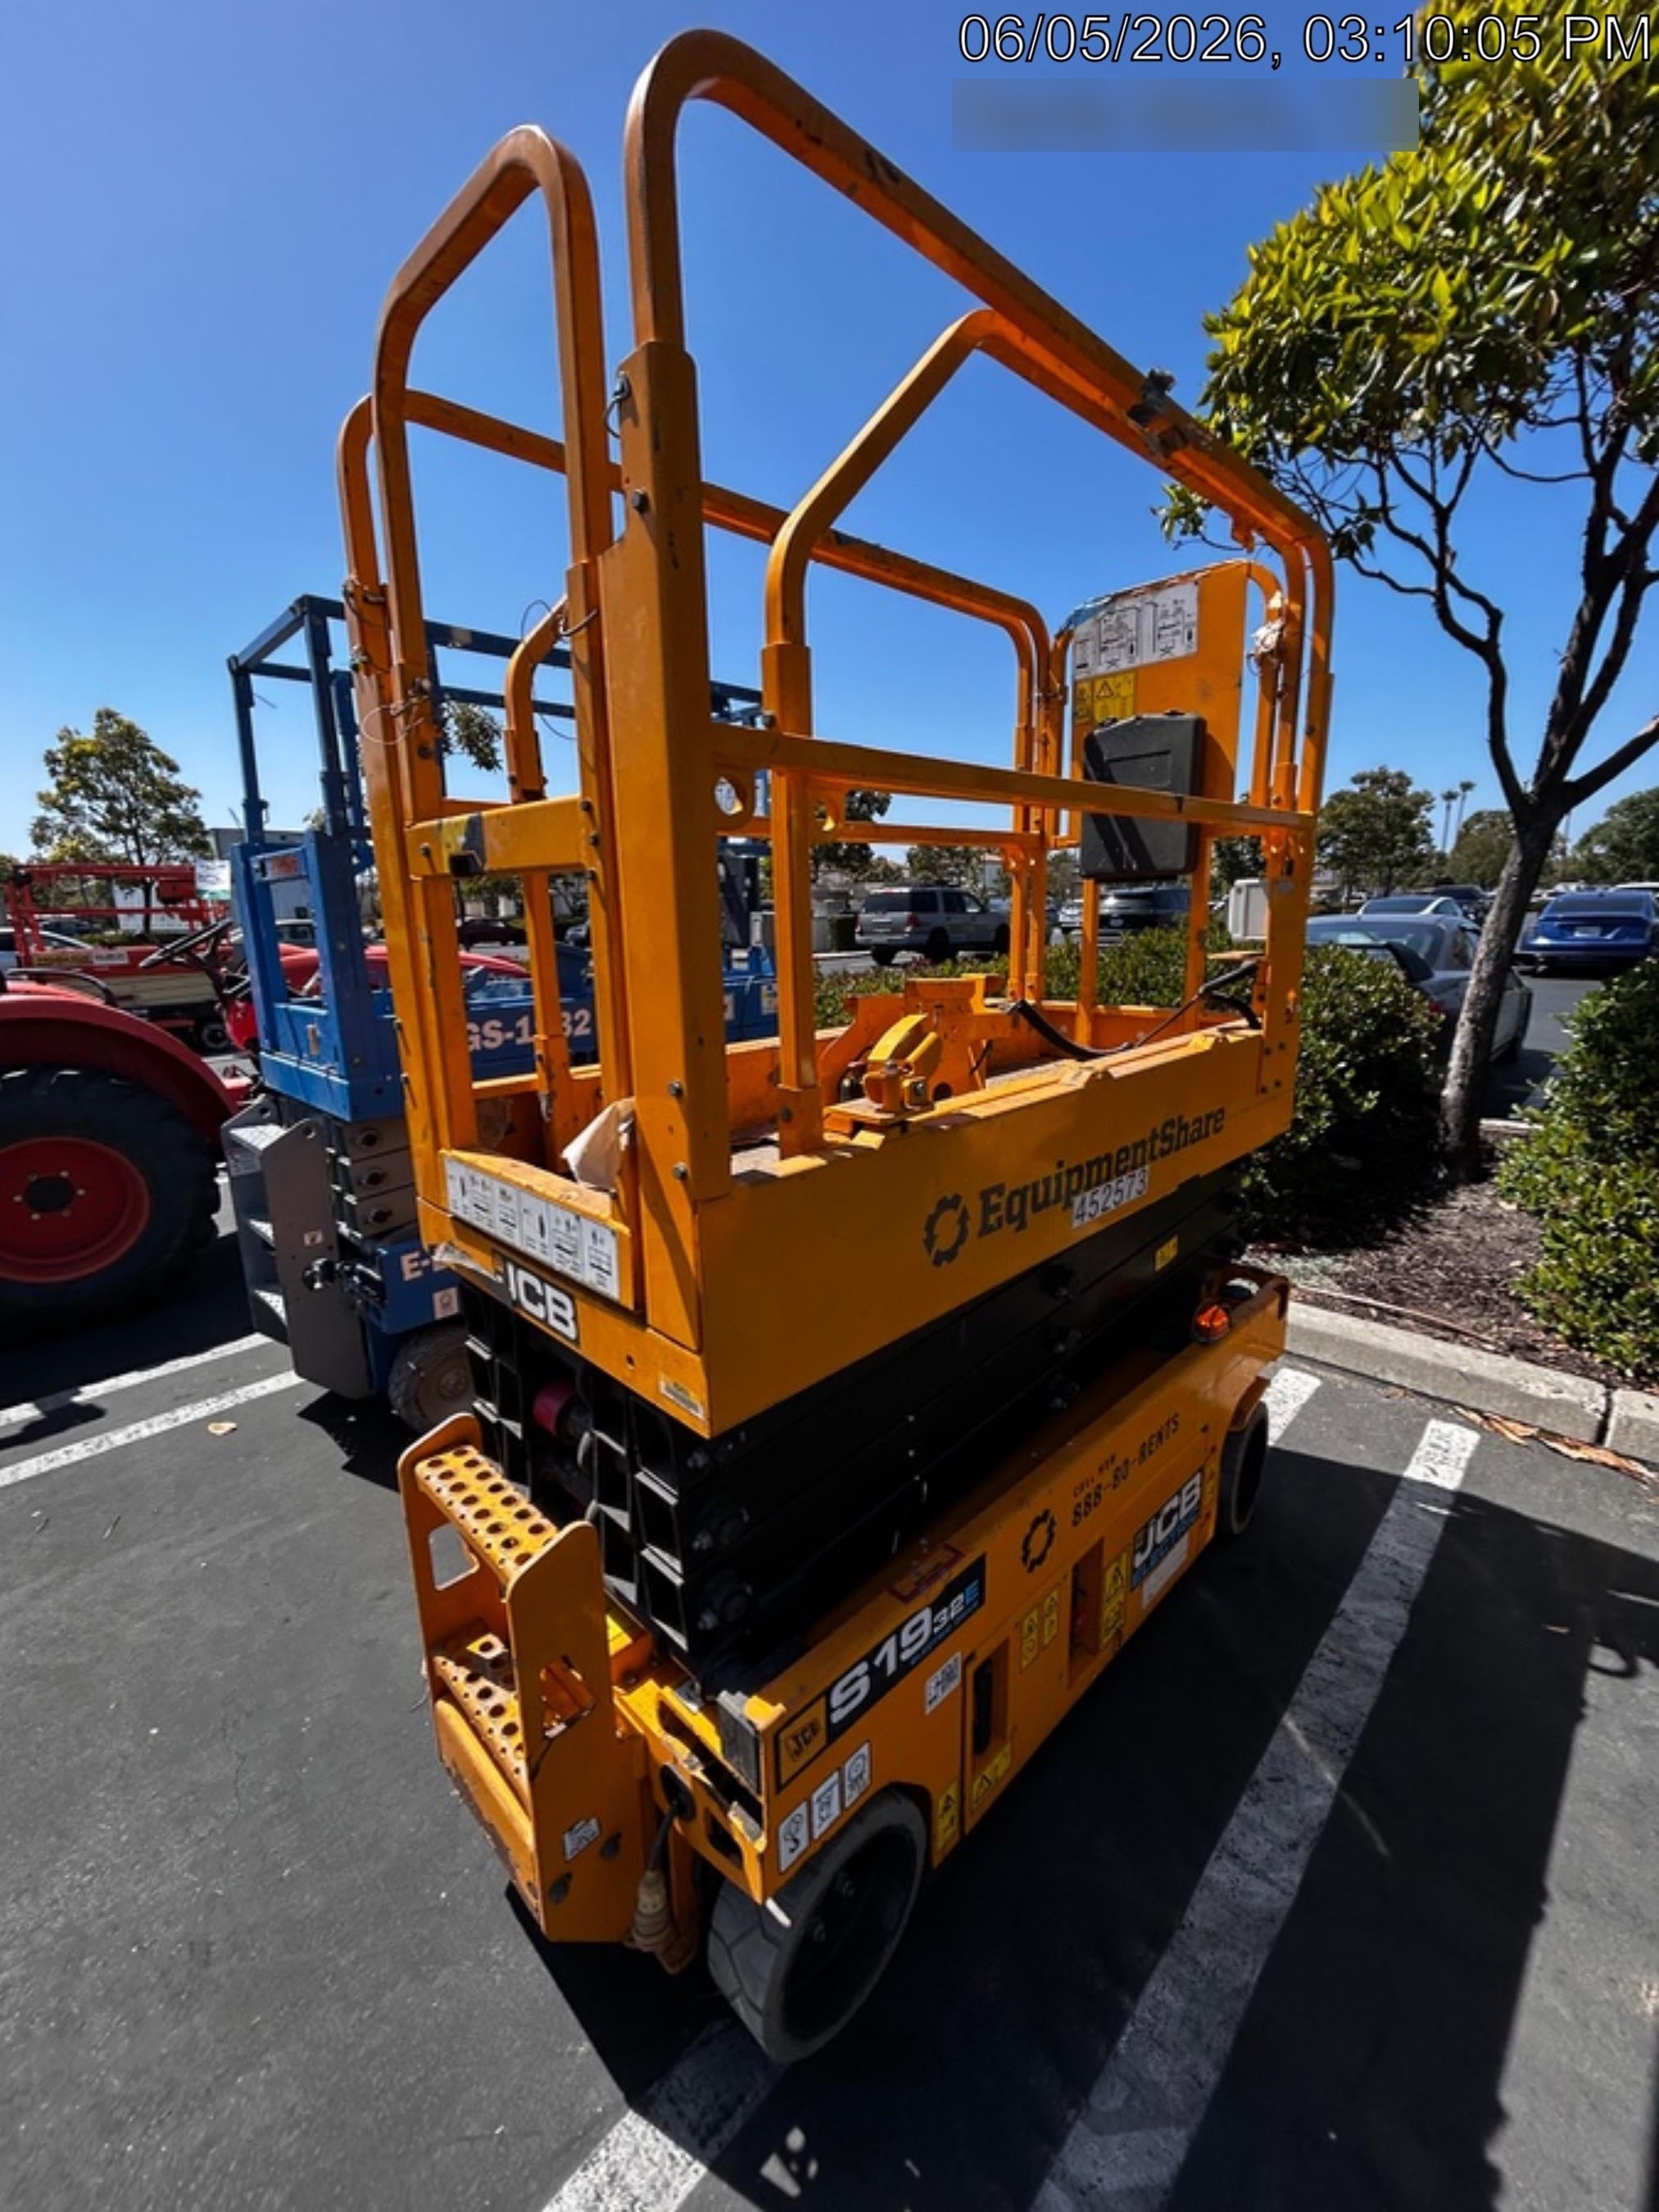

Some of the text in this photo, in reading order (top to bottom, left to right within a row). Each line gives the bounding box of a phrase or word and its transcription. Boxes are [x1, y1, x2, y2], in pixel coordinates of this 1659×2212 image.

[466, 1009, 591, 1051] GS-132
[978, 1107, 1225, 1239] EquipmentShare
[1075, 1169, 1146, 1222] 452573
[1135, 1471, 1202, 1569] JCB
